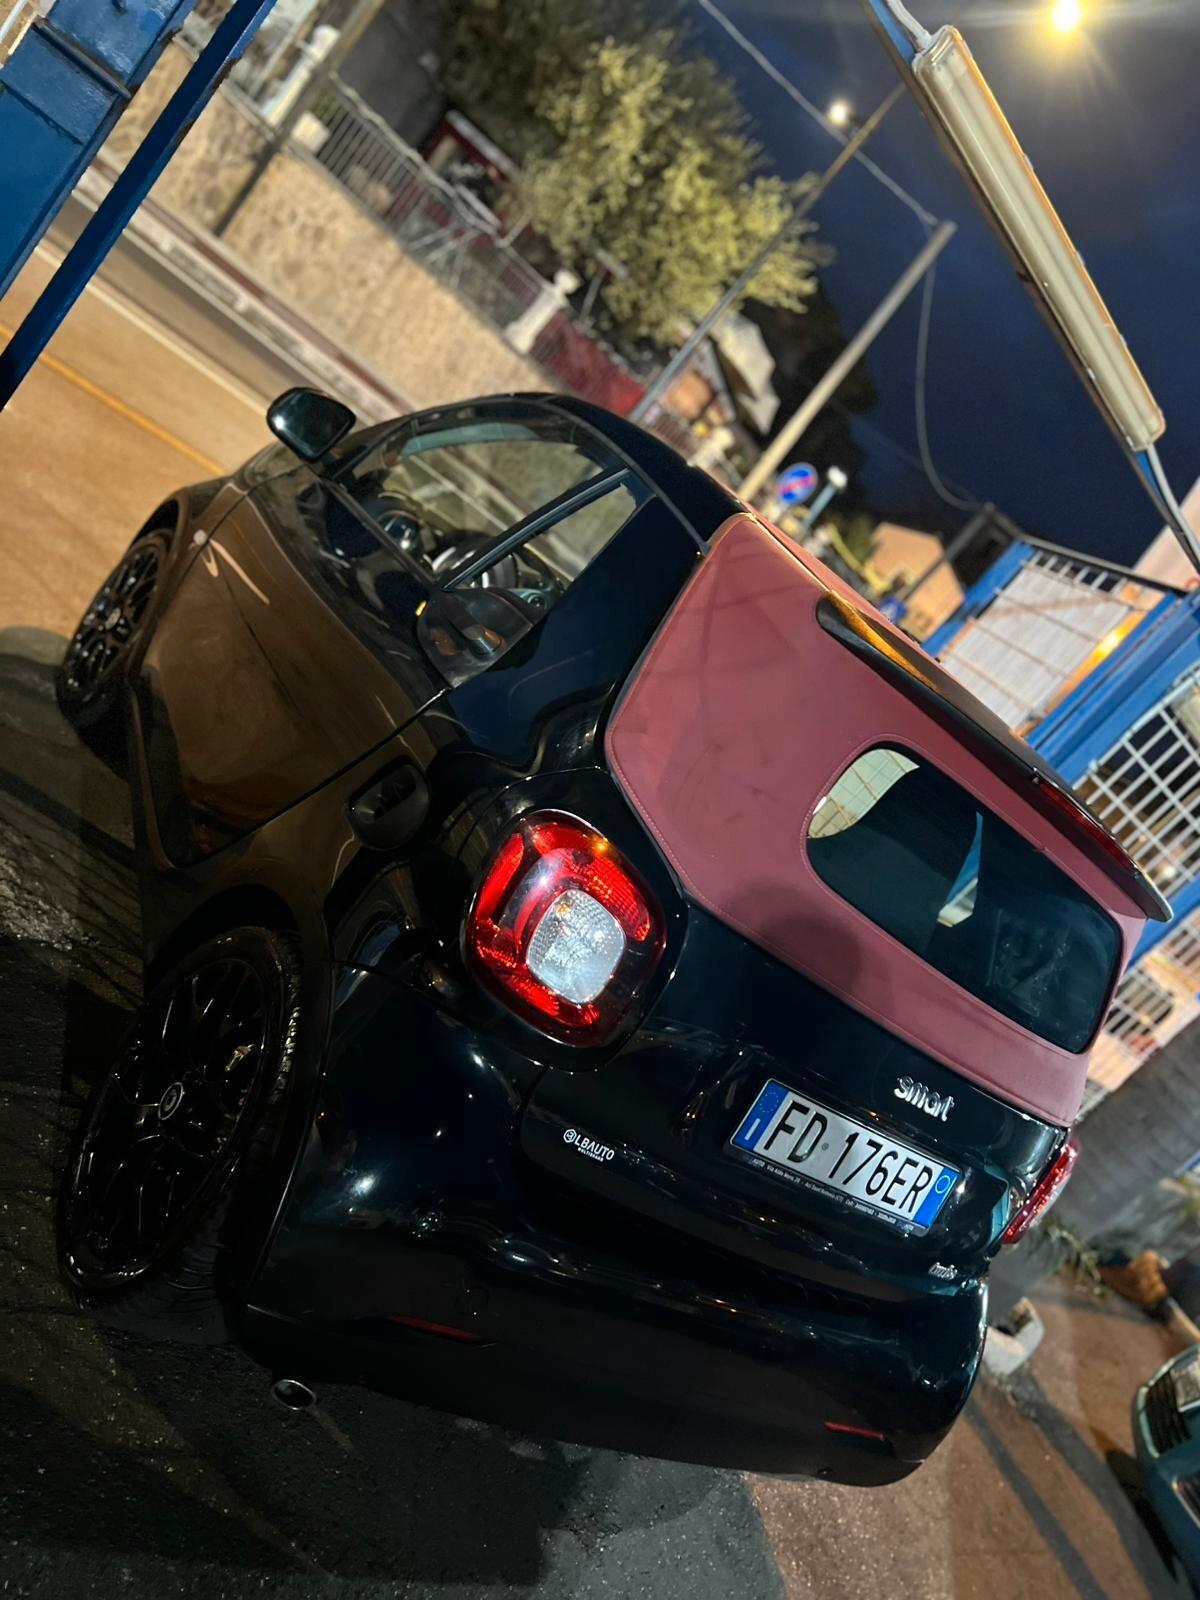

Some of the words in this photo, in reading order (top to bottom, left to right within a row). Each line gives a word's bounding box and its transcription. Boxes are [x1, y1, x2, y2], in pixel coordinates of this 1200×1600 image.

[894, 1076, 955, 1122] smart
[574, 1134, 615, 1160] LBAUTO
[744, 1118, 761, 1140] I
[763, 1101, 828, 1164] FD
[828, 1132, 934, 1214] 176ER
